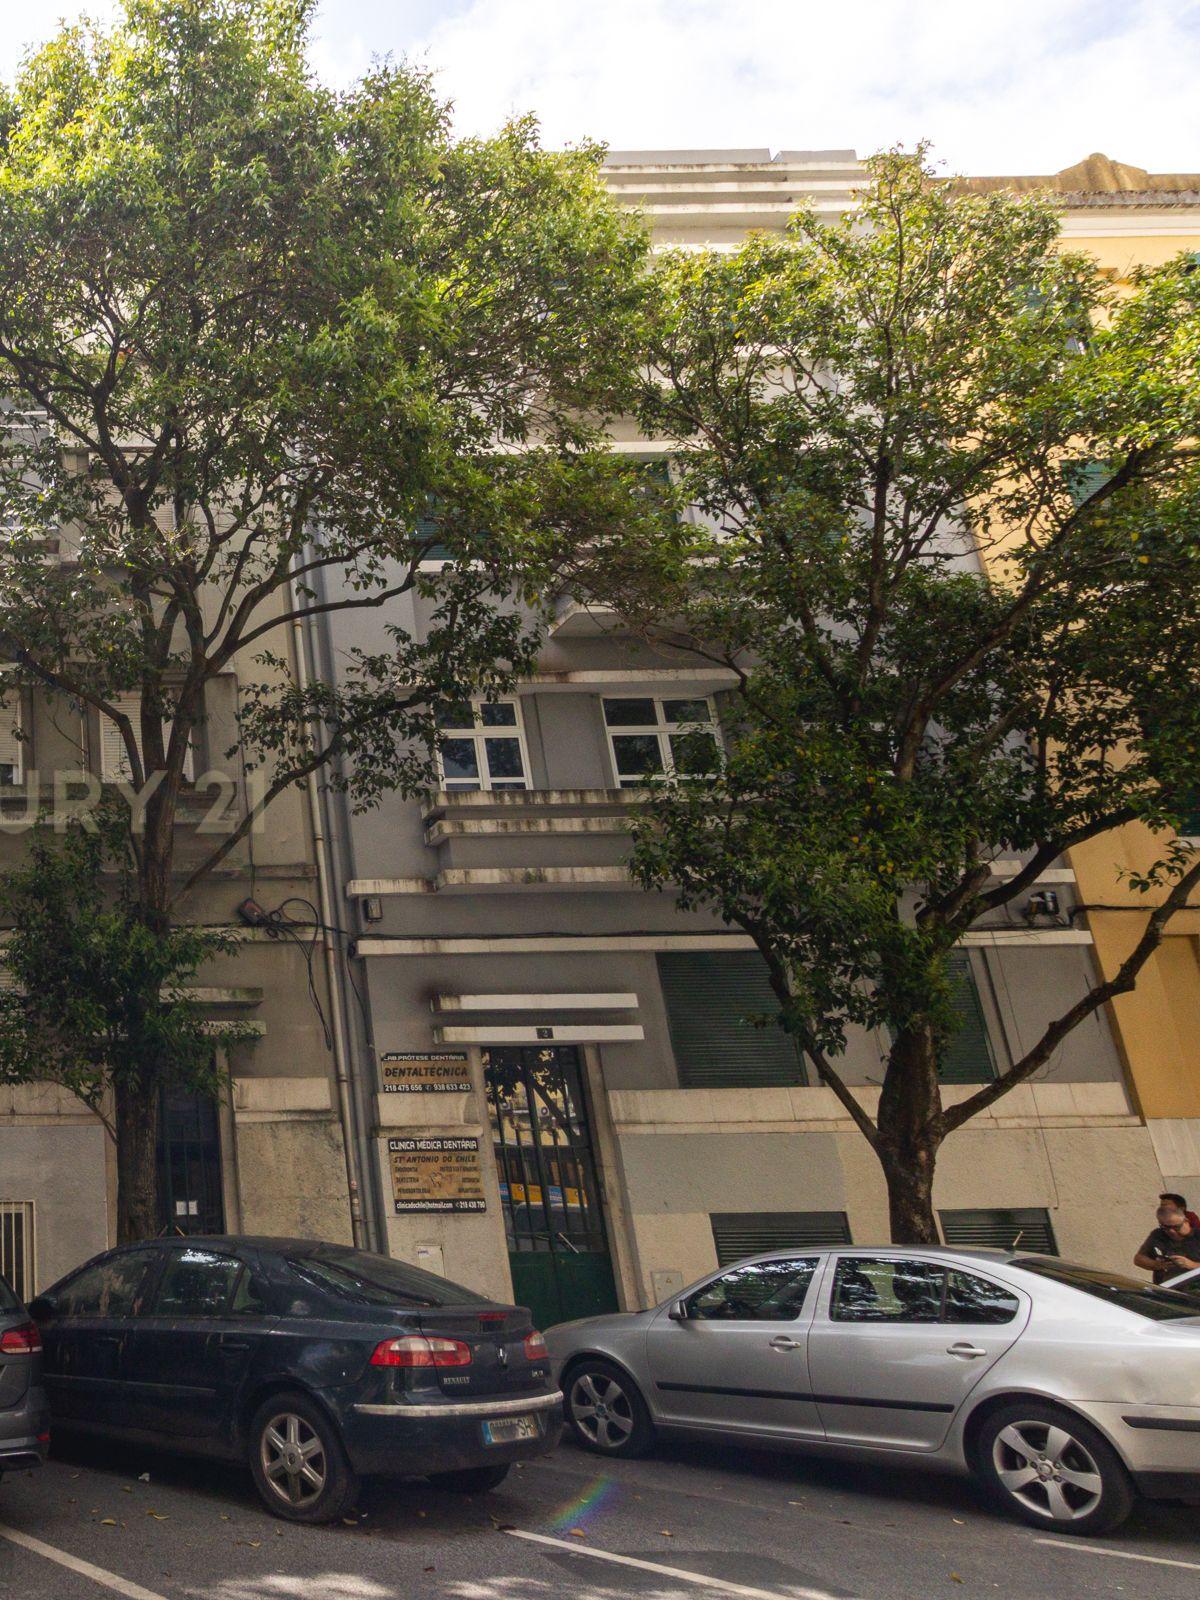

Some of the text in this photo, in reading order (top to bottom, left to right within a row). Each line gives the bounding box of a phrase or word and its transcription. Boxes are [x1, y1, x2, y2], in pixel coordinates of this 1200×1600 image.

[384, 1064, 468, 1078] DENTALTÉCNICA
[417, 1139, 441, 1150] MÉDICA
[443, 1139, 477, 1149] DENTÁRIA
[443, 1376, 471, 1385] RENAULT
